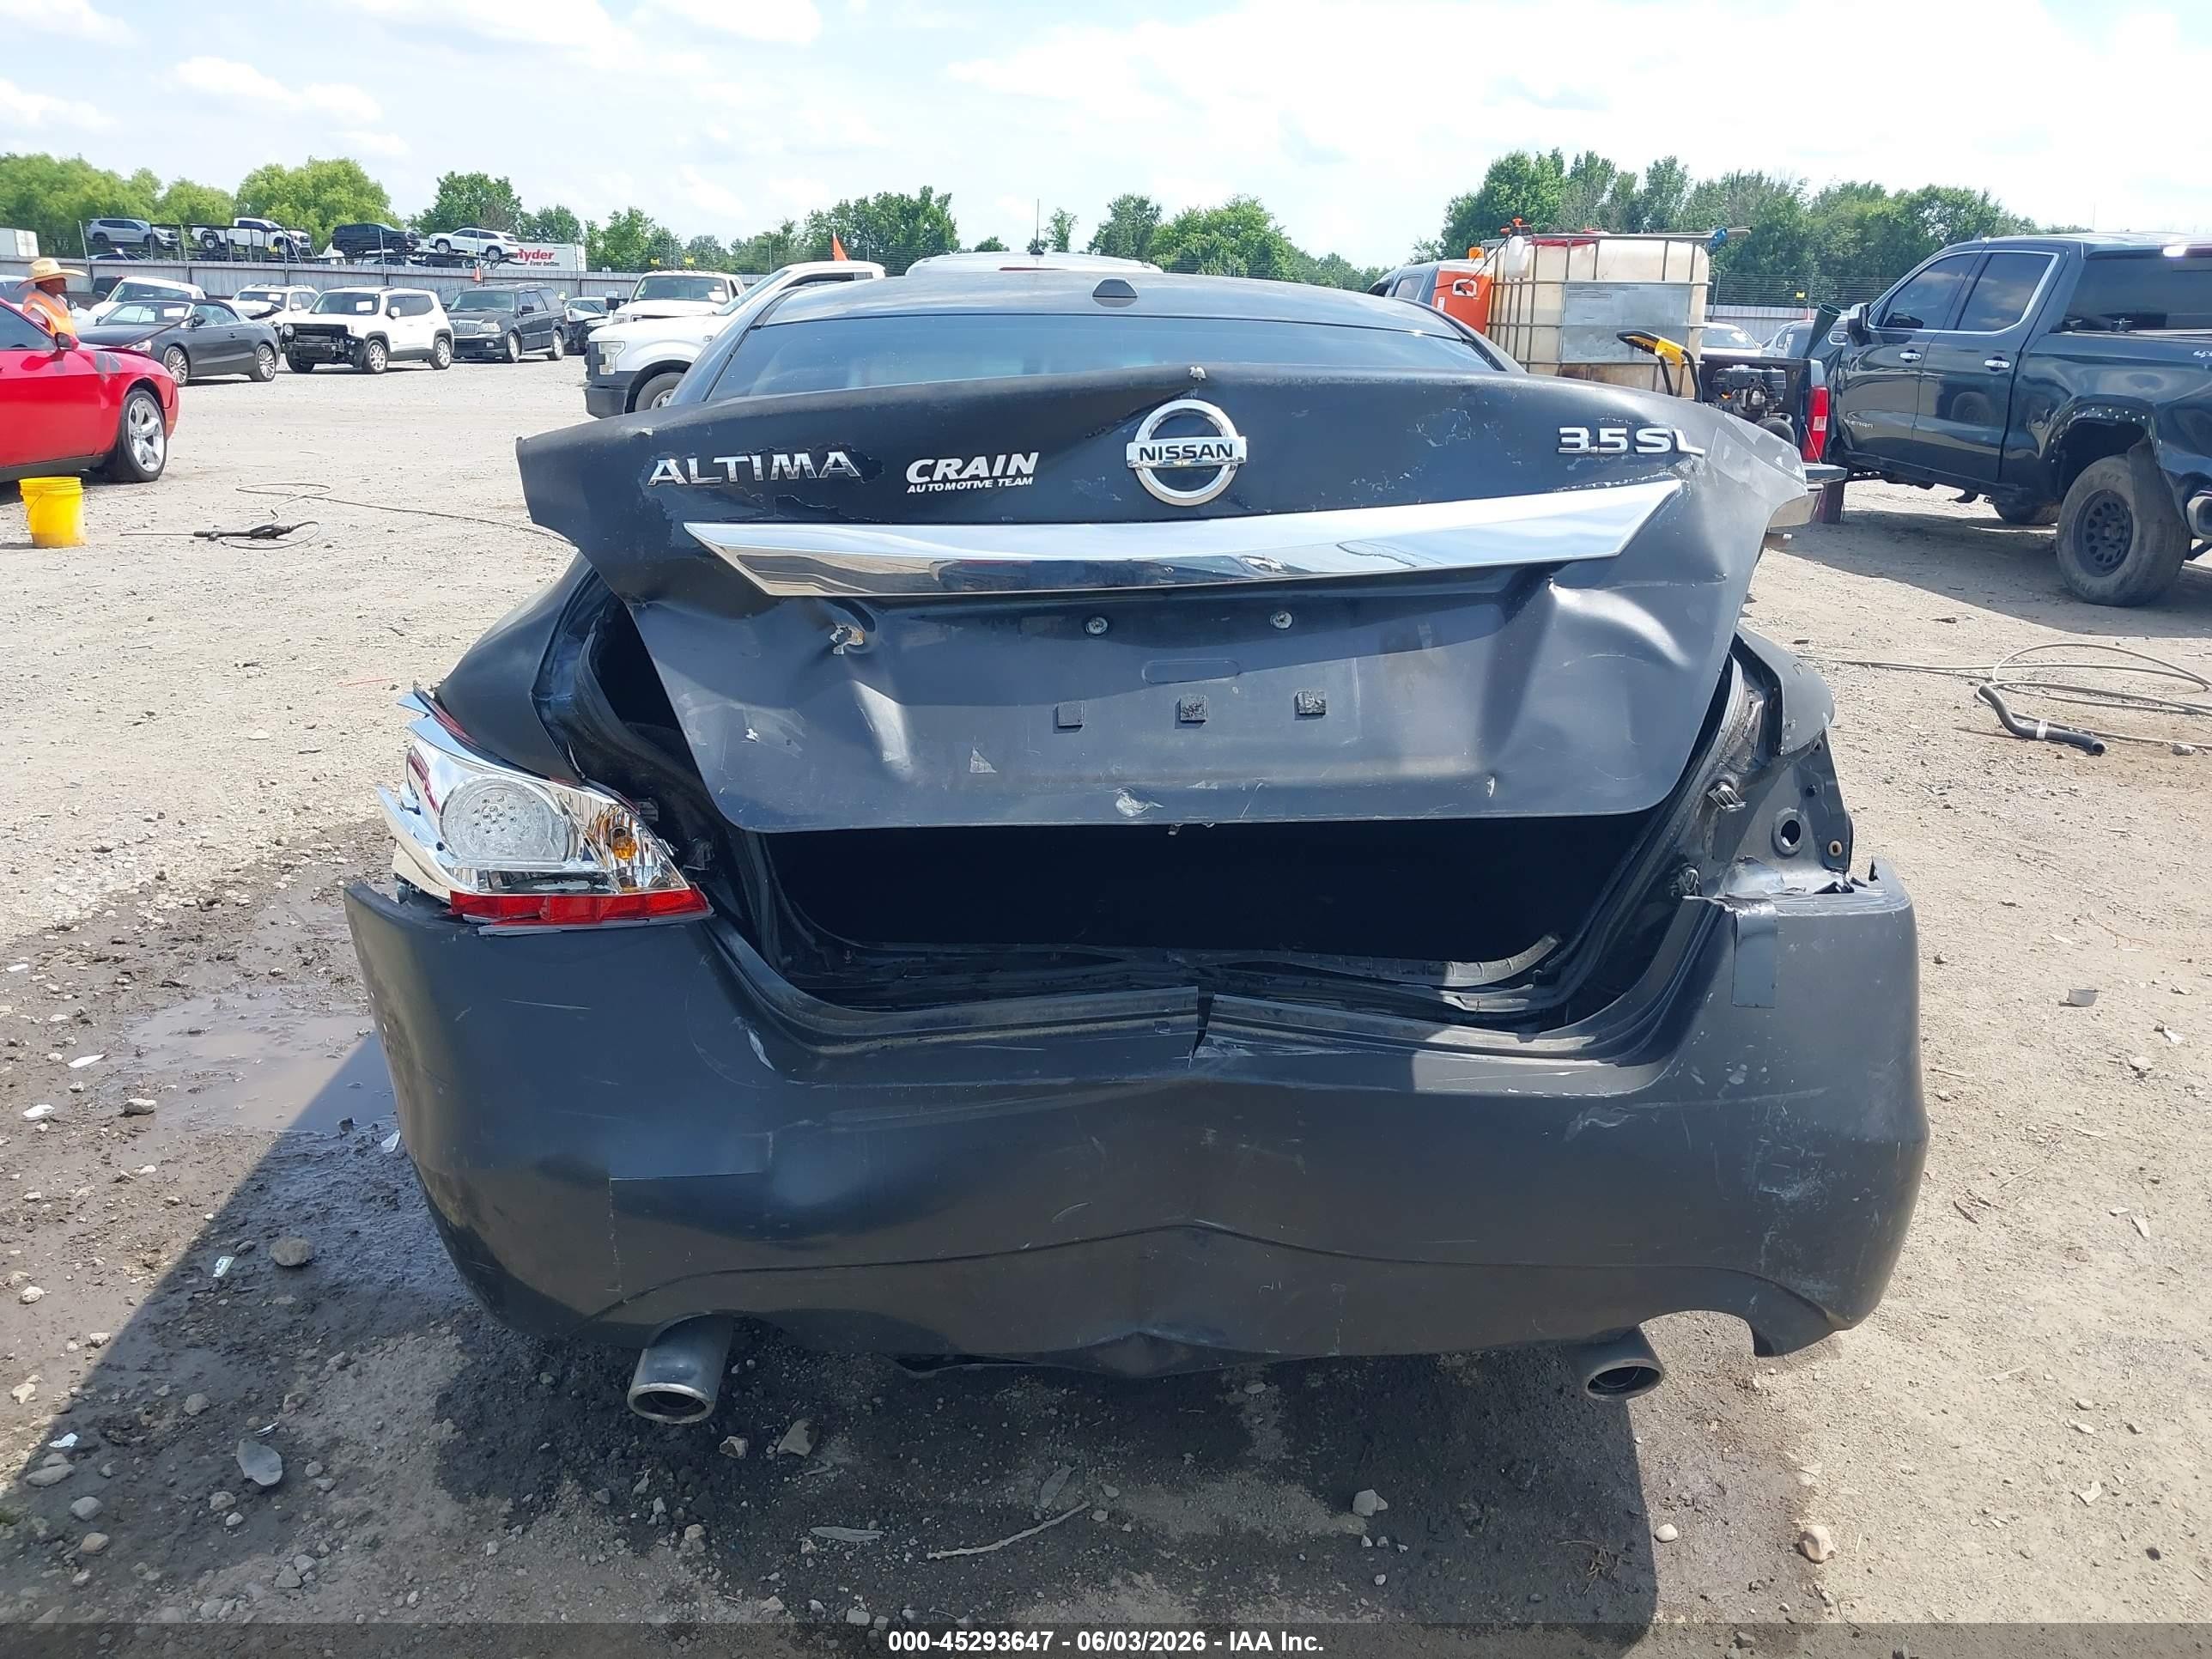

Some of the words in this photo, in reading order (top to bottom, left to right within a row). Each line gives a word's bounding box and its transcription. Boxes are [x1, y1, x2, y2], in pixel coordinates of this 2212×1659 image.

[1139, 443, 1233, 461] NISSAN
[647, 451, 861, 486] ALTIMA
[906, 452, 1039, 483] CRAIN
[907, 479, 994, 494] AUTOMOTIVE
[998, 477, 1033, 487] TEAM
